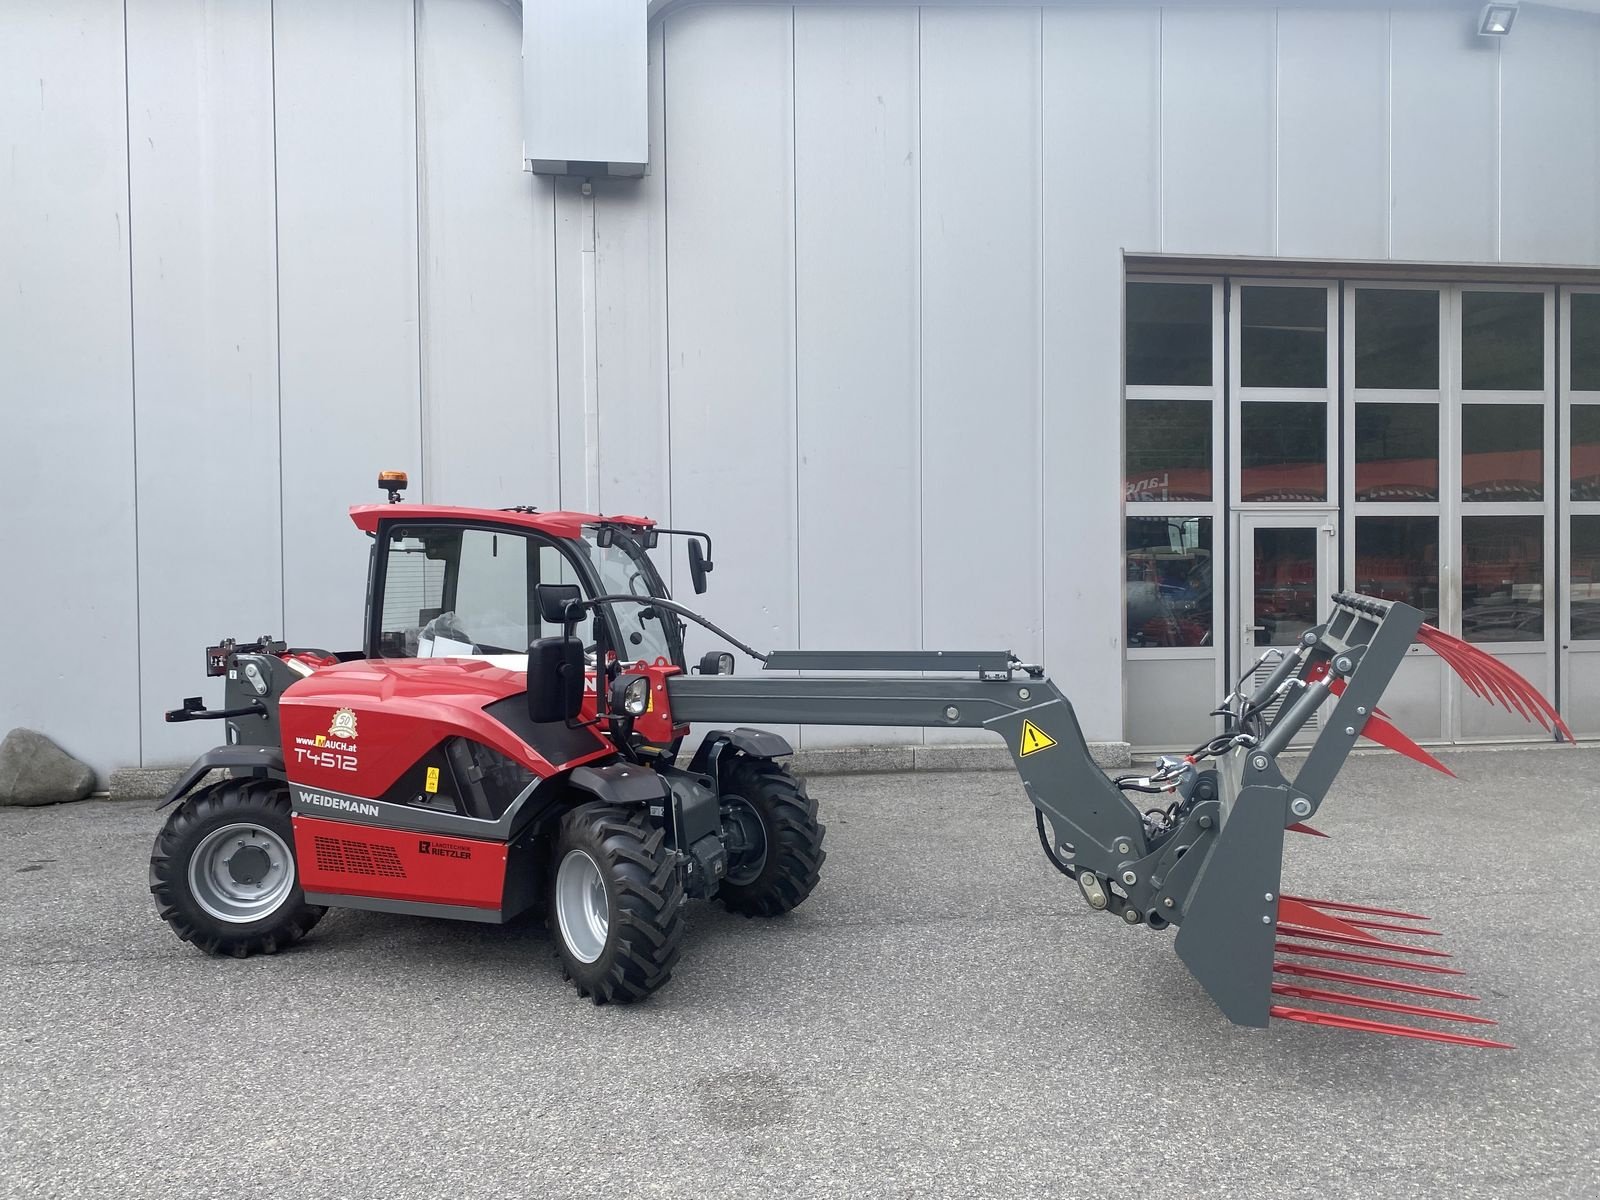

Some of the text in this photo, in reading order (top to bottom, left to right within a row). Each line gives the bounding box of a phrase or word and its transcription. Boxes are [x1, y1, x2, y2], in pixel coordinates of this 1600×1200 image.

[294, 748, 358, 771] T4512
[299, 791, 379, 817] WEIDEMANN
[432, 847, 471, 860] RIETZLER
